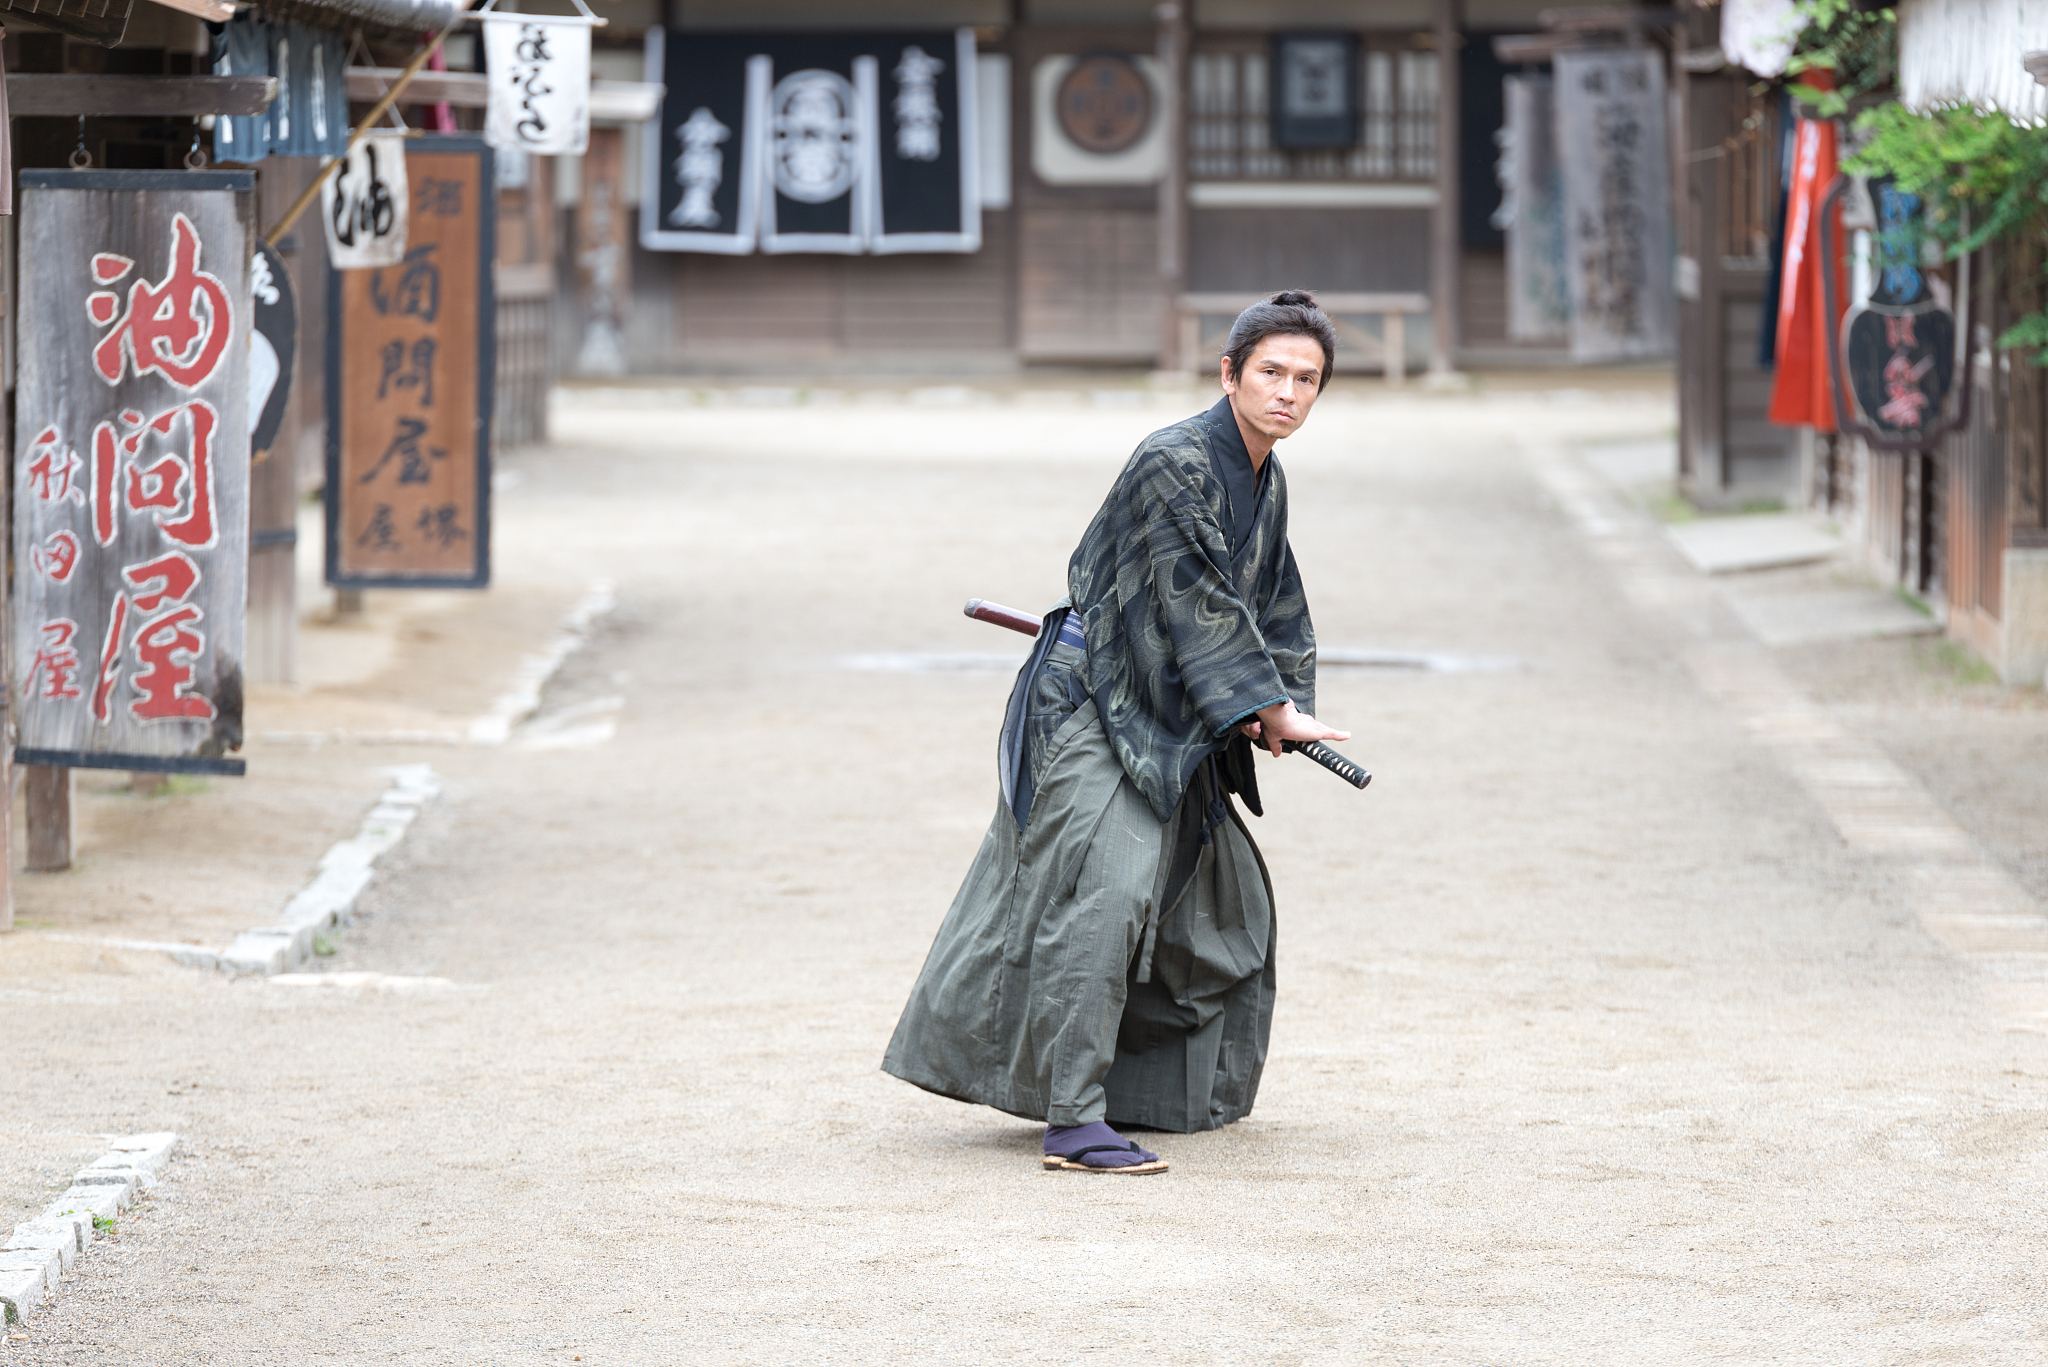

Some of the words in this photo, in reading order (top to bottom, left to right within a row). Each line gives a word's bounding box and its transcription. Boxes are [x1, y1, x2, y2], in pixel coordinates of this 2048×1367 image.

[24, 423, 84, 698] 秋田屋
[86, 211, 235, 725] 油問屋
